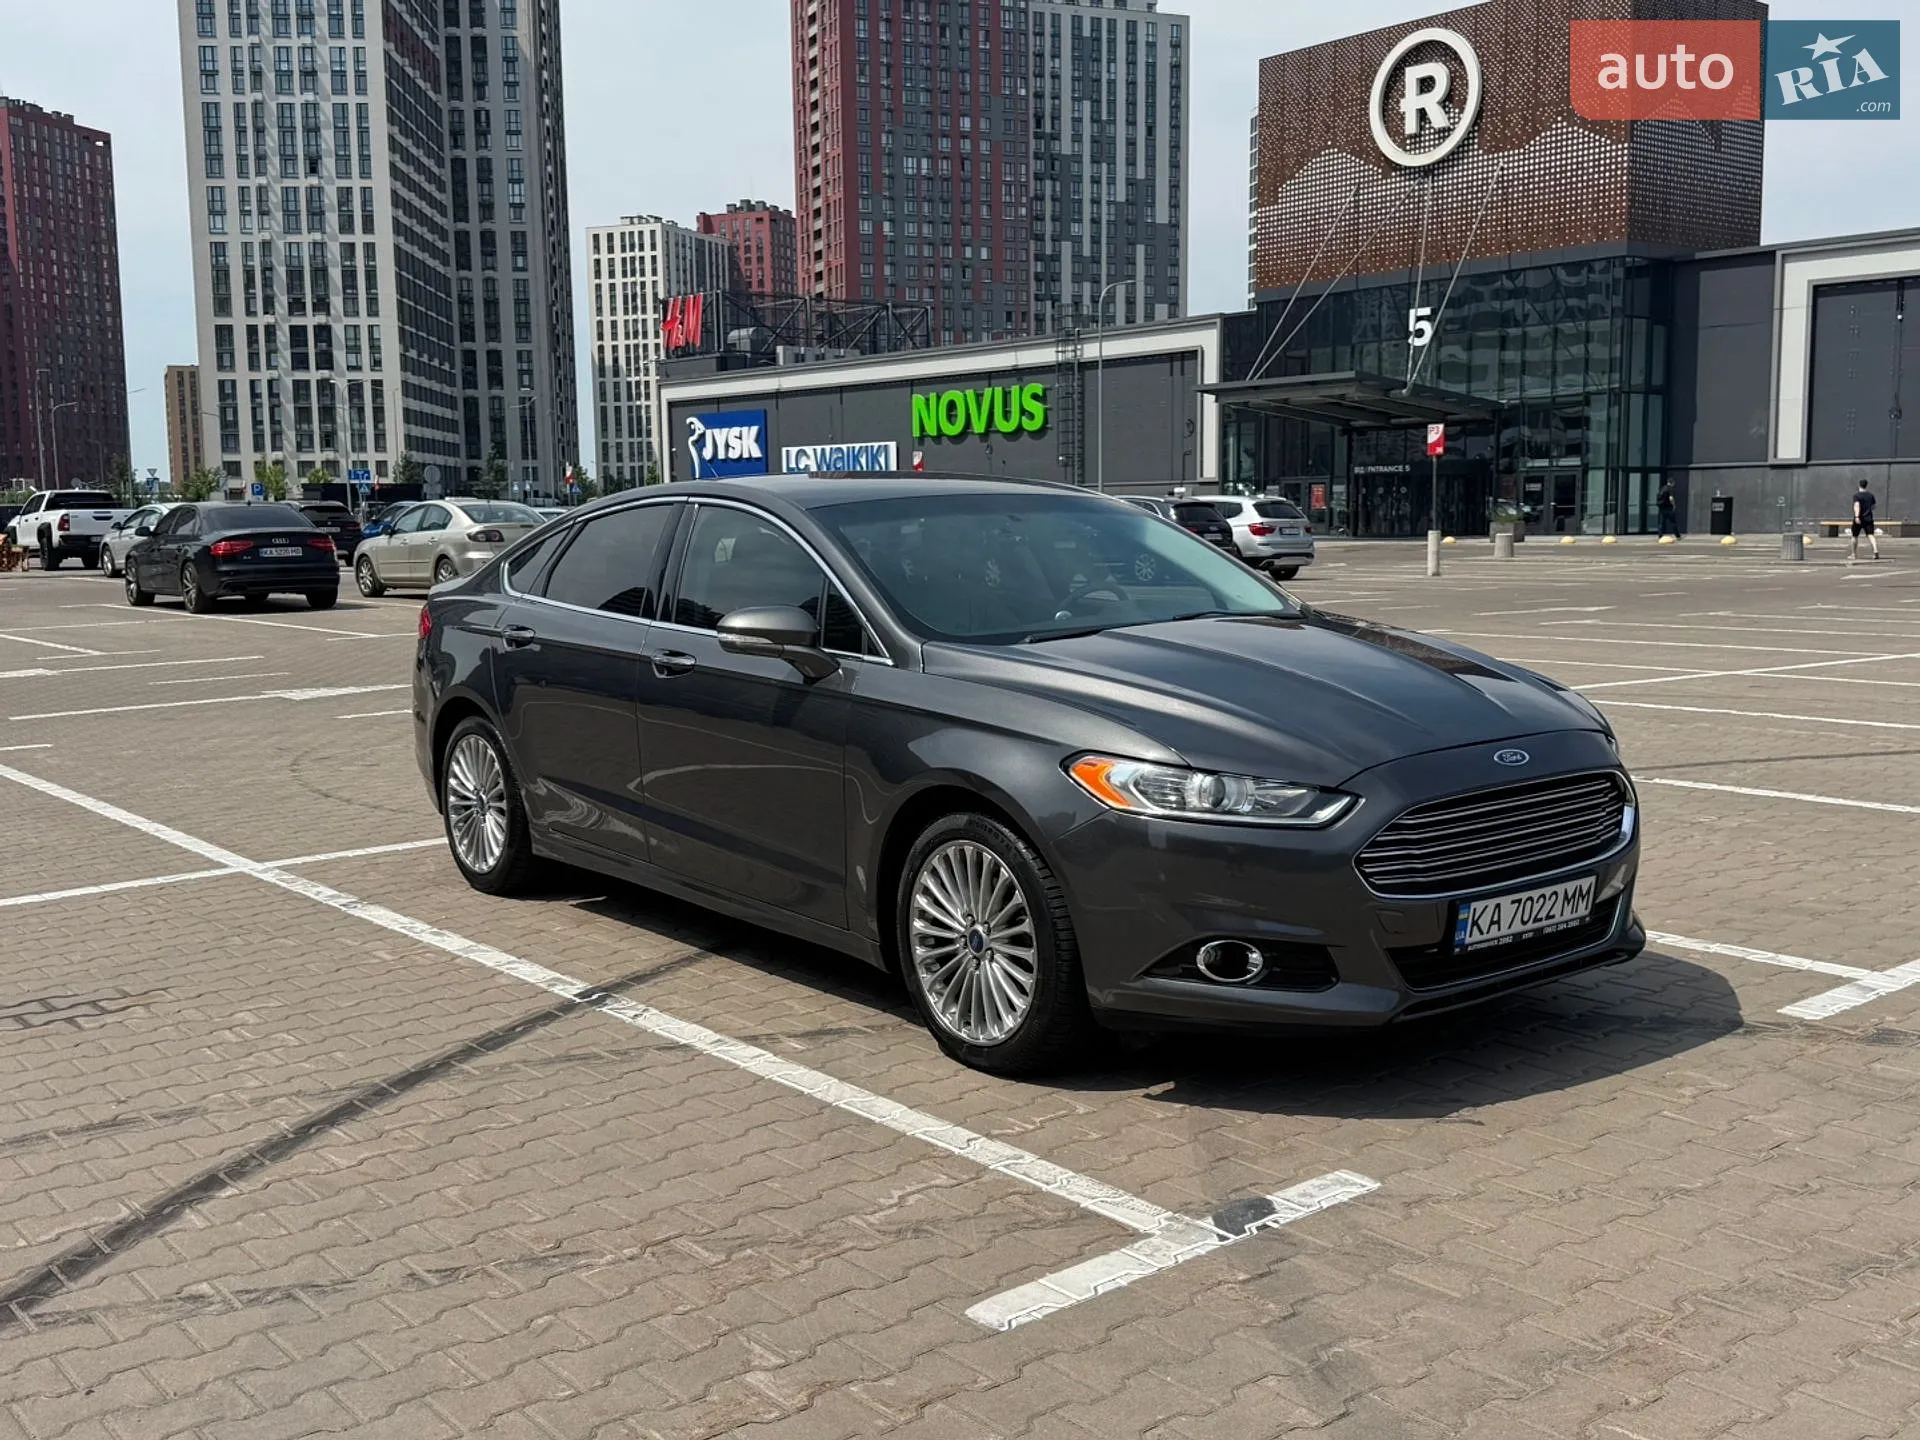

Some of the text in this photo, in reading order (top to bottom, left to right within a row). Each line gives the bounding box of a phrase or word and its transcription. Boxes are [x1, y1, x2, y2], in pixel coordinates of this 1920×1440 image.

[660, 292, 704, 352] H&M
[1408, 307, 1434, 347] 5
[912, 382, 1045, 438] NOVUS
[702, 425, 763, 461] JYSK
[786, 448, 811, 474] LC
[1469, 902, 1502, 938] KA
[1507, 890, 1559, 930] 7022
[1560, 881, 1593, 917] MM
